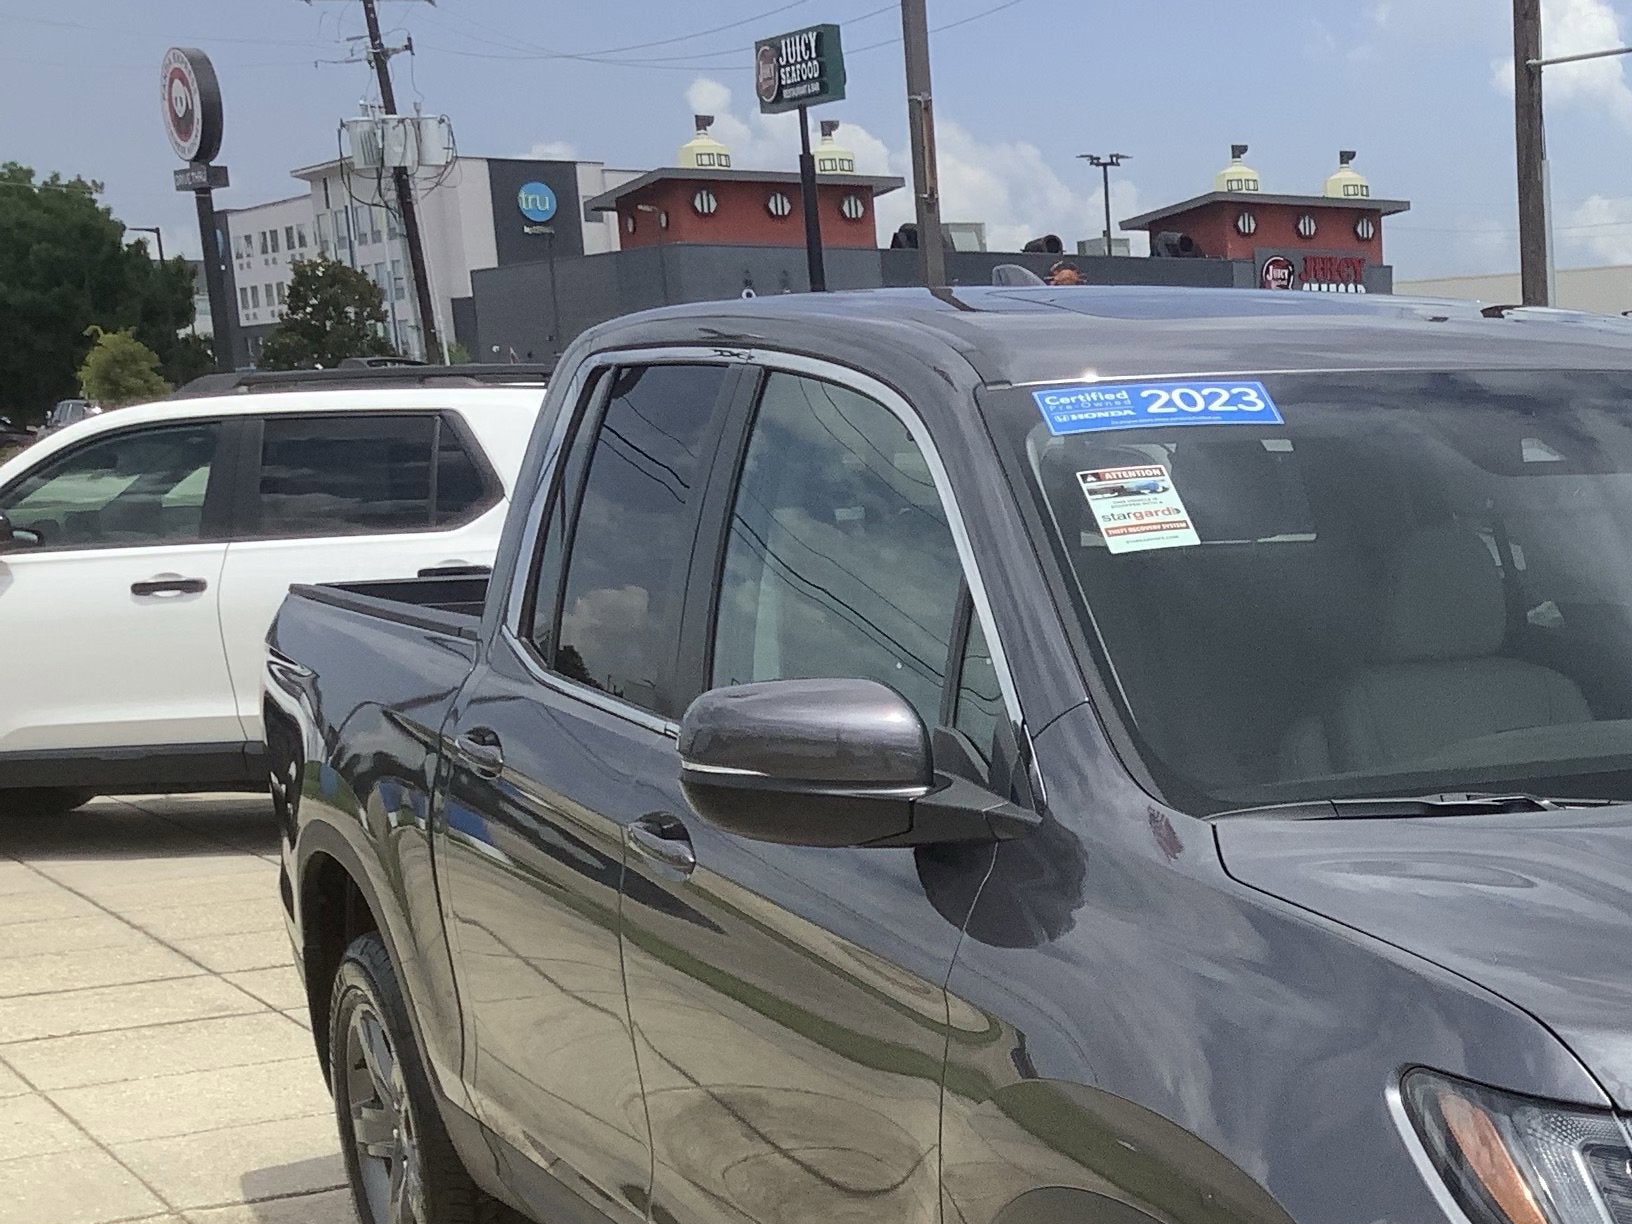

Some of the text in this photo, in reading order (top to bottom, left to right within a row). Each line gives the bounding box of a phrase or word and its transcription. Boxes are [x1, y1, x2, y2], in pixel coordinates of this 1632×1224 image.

[779, 31, 818, 66] JUICY
[780, 59, 820, 85] SEAFOOD
[1298, 256, 1366, 283] JUICY
[1044, 389, 1129, 406] Certified
[1140, 387, 1266, 413] 2023
[1070, 409, 1137, 421] HONDA
[1103, 468, 1162, 481] ATTENTION
[1101, 506, 1172, 522] stargard
